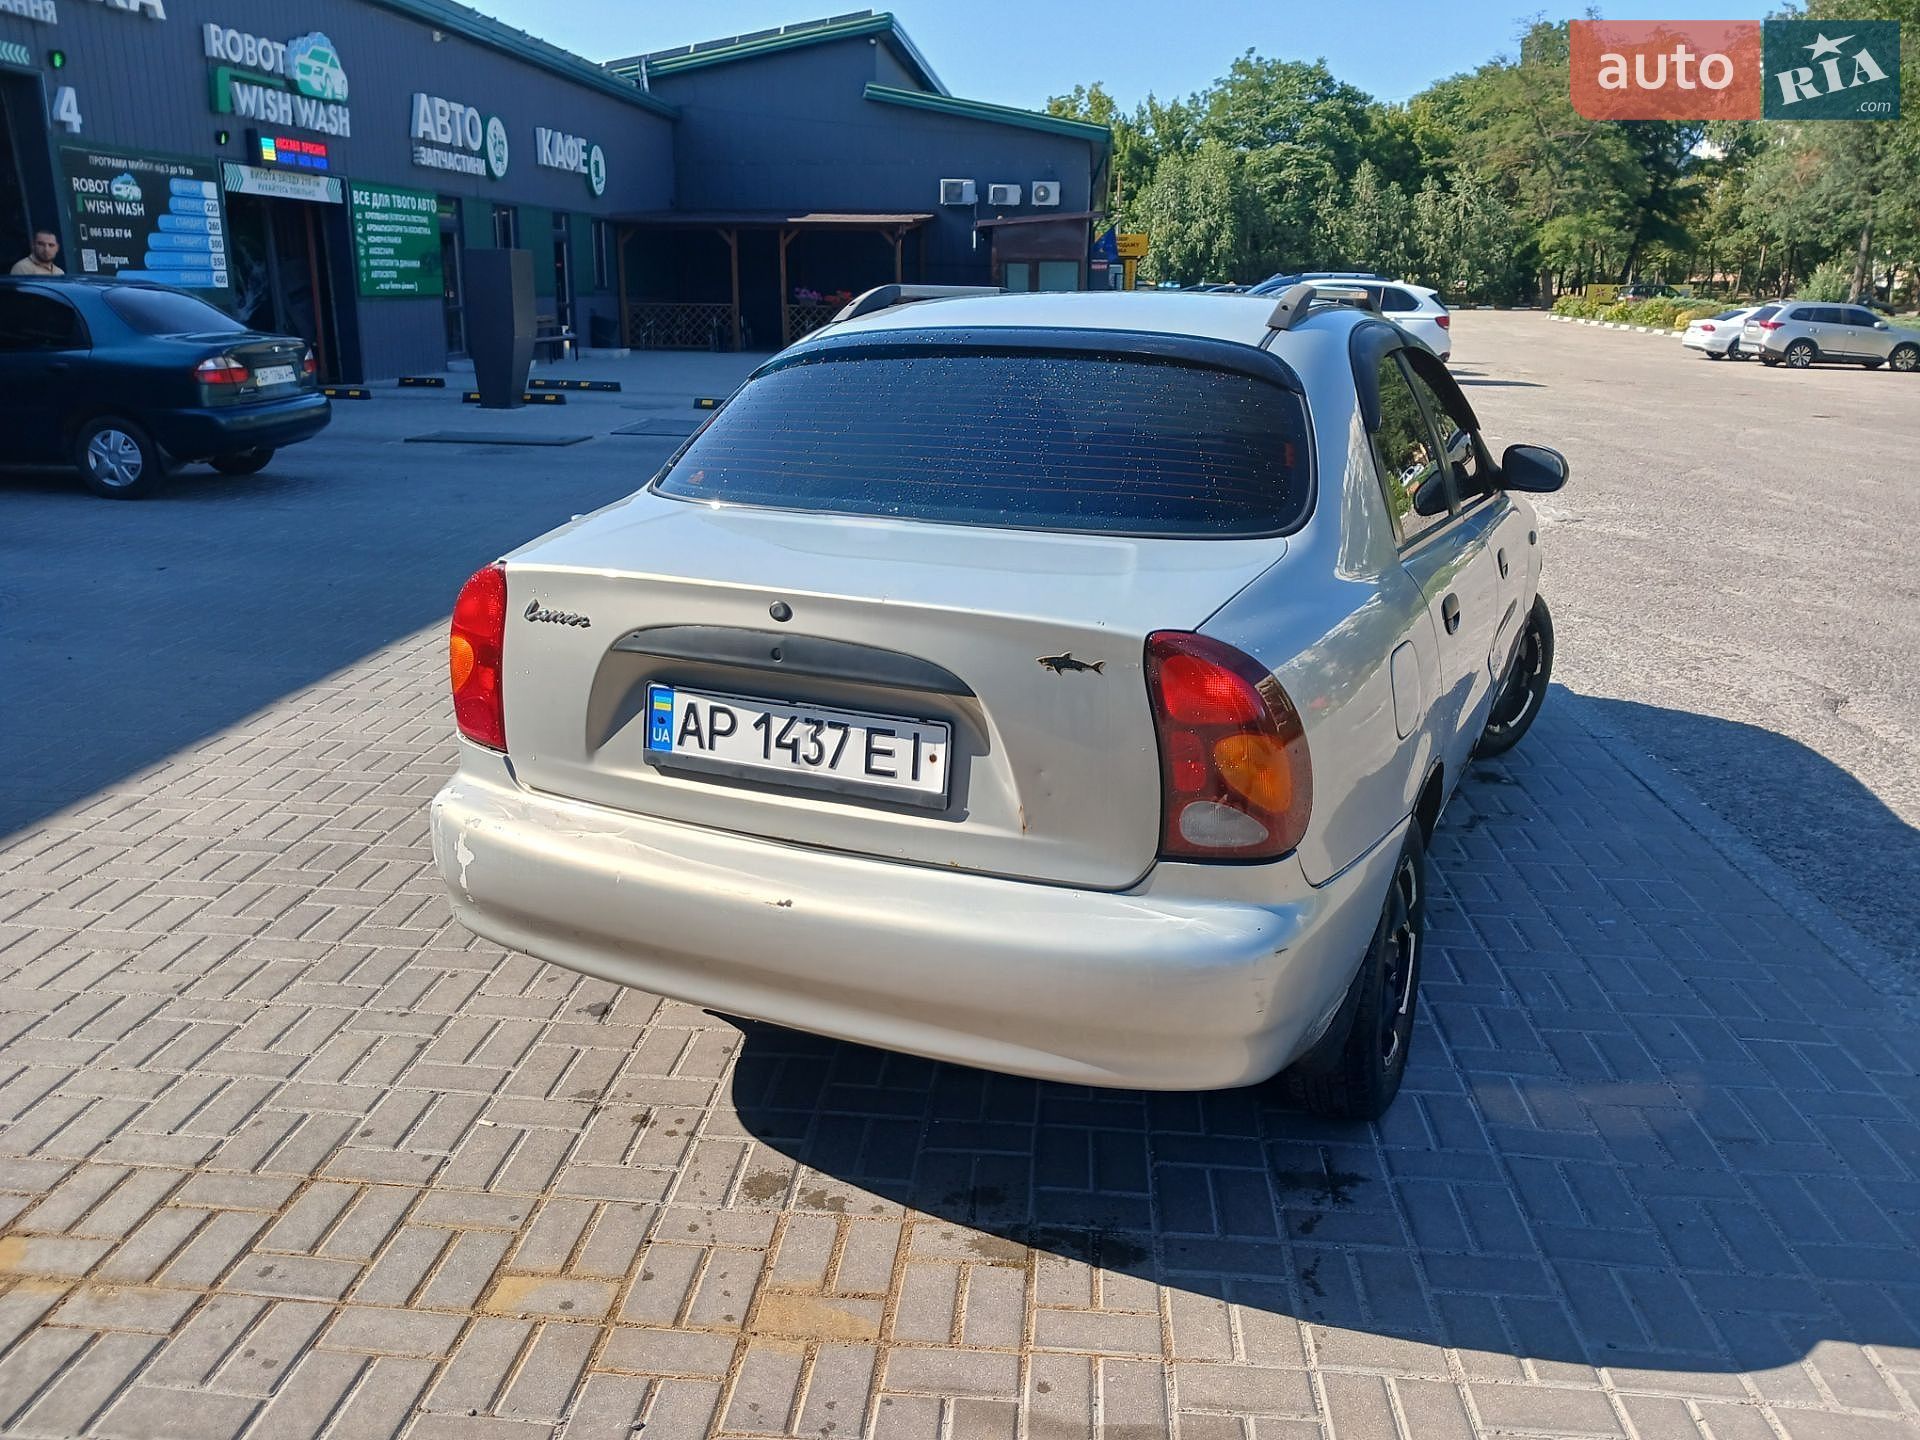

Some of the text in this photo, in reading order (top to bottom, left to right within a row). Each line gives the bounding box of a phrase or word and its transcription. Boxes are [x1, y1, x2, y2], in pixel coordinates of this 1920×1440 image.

[203, 23, 286, 74] ROBOT
[53, 86, 82, 133] 4
[232, 82, 350, 137] WISH WASH
[411, 93, 483, 151] АВТО
[414, 146, 487, 176] ЗАПЧАСТИНИ
[536, 127, 589, 174] КАФЕ
[72, 177, 110, 193] ROBOT
[84, 199, 145, 216] WISH WASH
[353, 190, 437, 213] ВСЕ ДЛЯ ТВОГО АВТО
[652, 727, 671, 743] UA
[677, 701, 737, 751] AP
[752, 711, 850, 770] 1437
